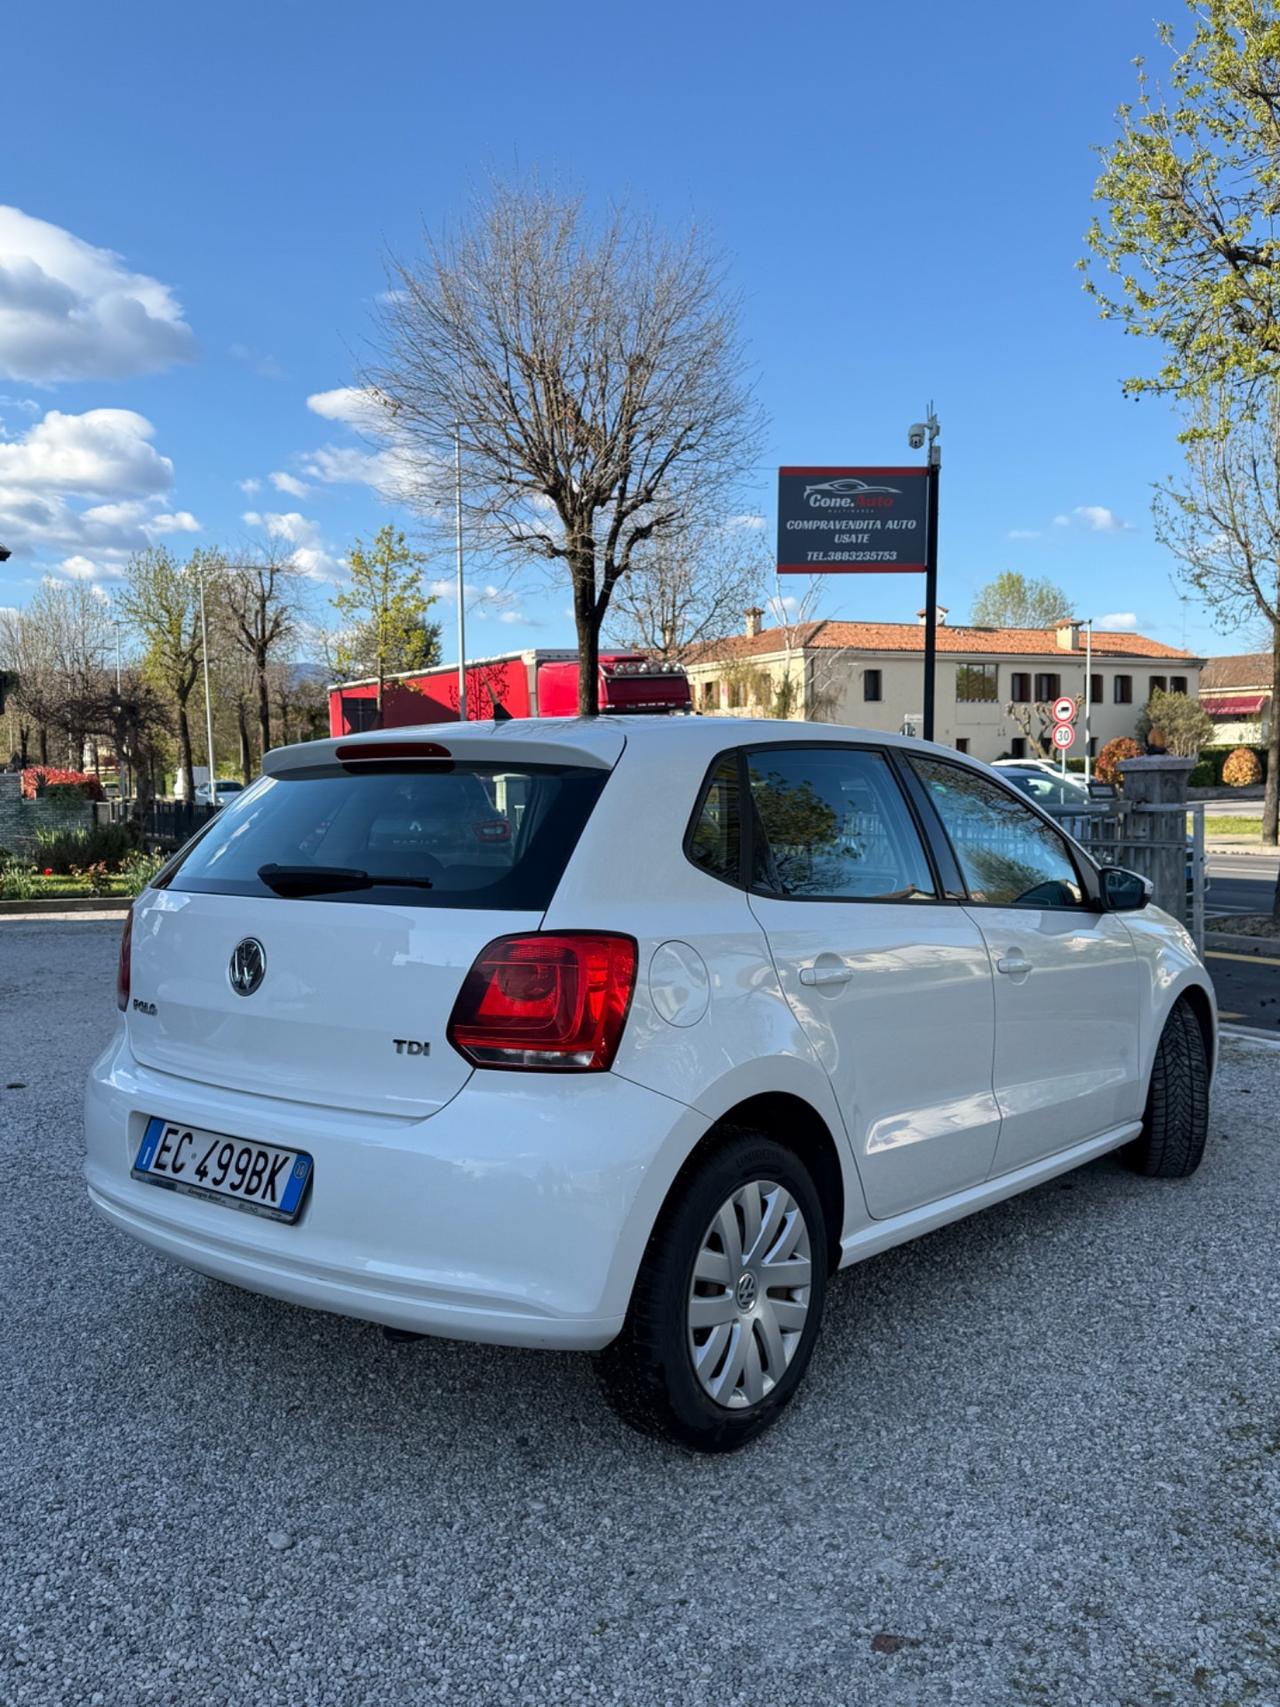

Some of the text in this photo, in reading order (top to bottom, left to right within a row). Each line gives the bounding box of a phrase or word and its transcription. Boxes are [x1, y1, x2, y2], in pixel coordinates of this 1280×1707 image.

[786, 519, 917, 530] COMPRAVENDITA AUTO
[834, 533, 871, 543] USATE
[1058, 730, 1069, 741] 30
[393, 1039, 430, 1057] TDI
